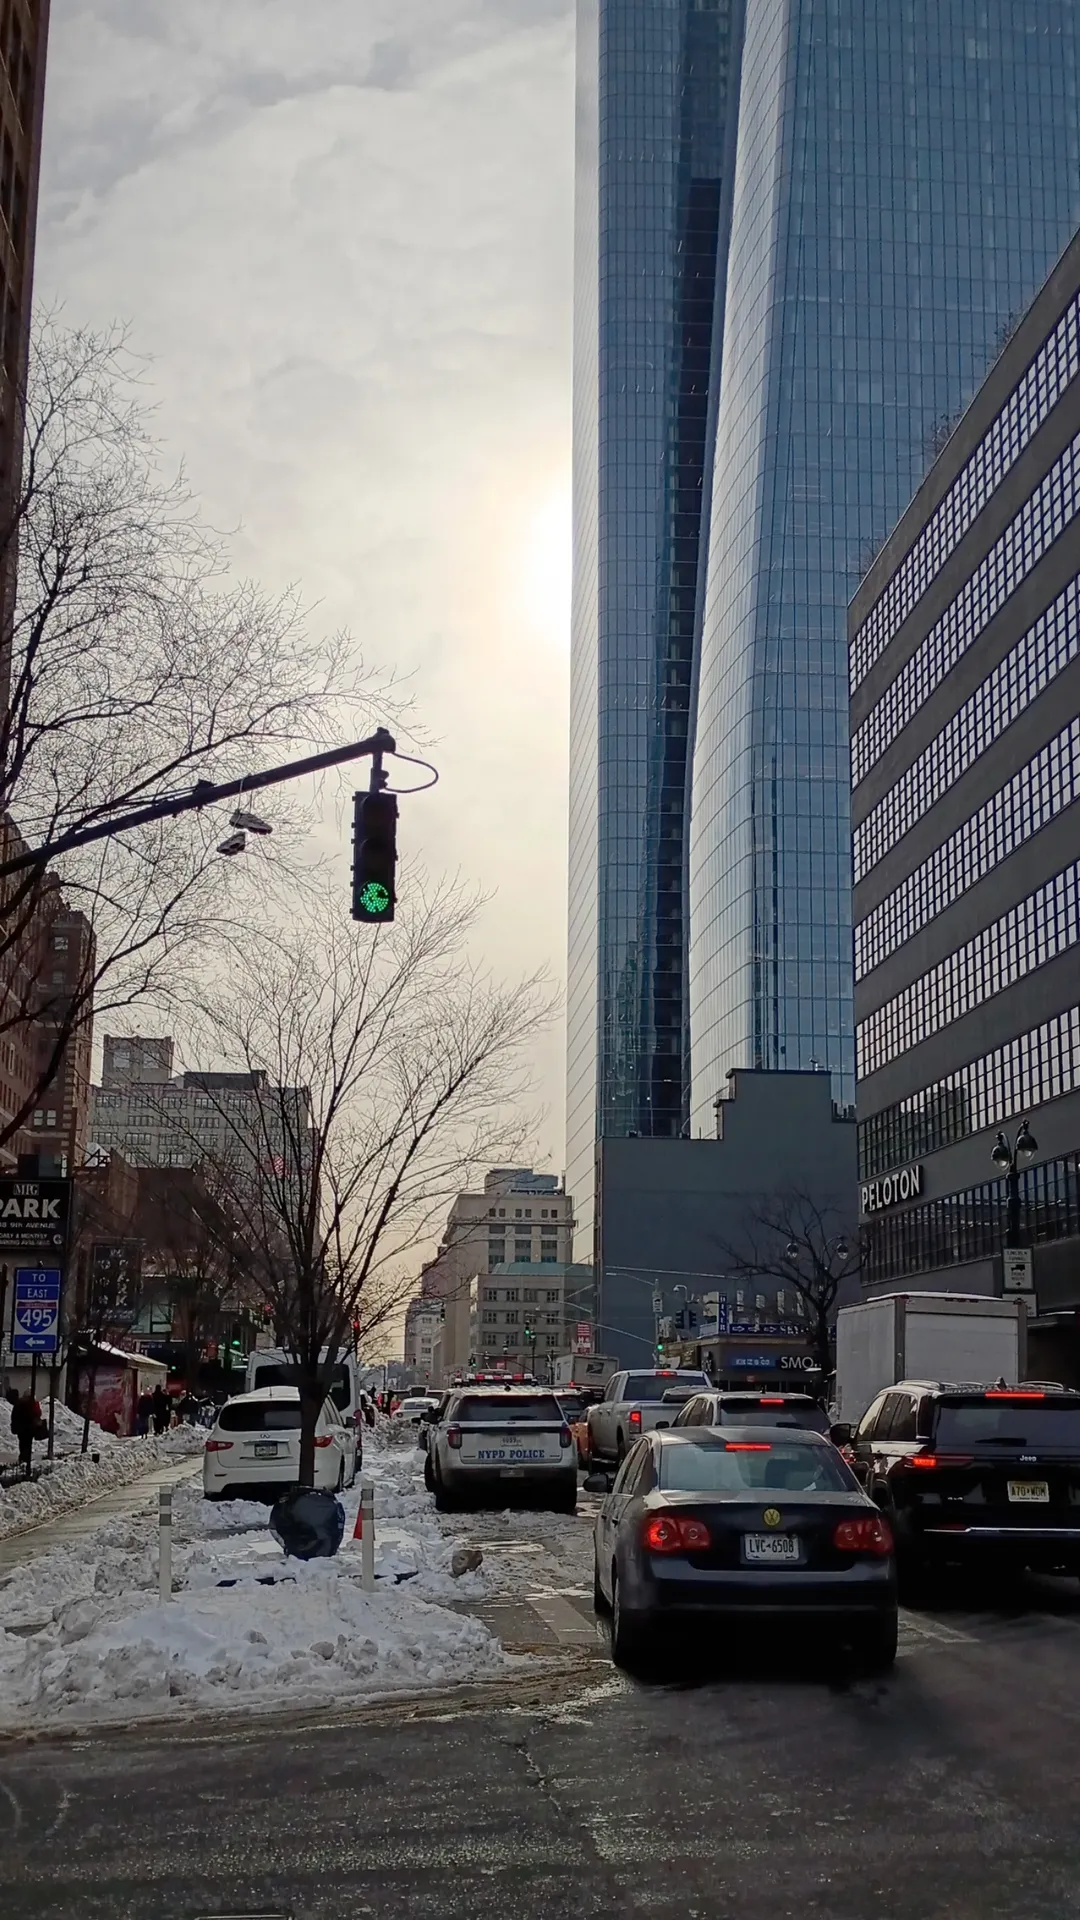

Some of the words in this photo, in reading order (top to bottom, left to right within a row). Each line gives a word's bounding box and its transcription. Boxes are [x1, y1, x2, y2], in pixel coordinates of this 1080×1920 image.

[861, 1165, 920, 1214] PELOTON
[32, 1273, 46, 1283] TO
[27, 1288, 48, 1298] EAST
[20, 1309, 53, 1327] 495
[780, 1357, 815, 1369] SMO
[478, 1450, 506, 1459] NYPD
[509, 1449, 545, 1459] POLICE
